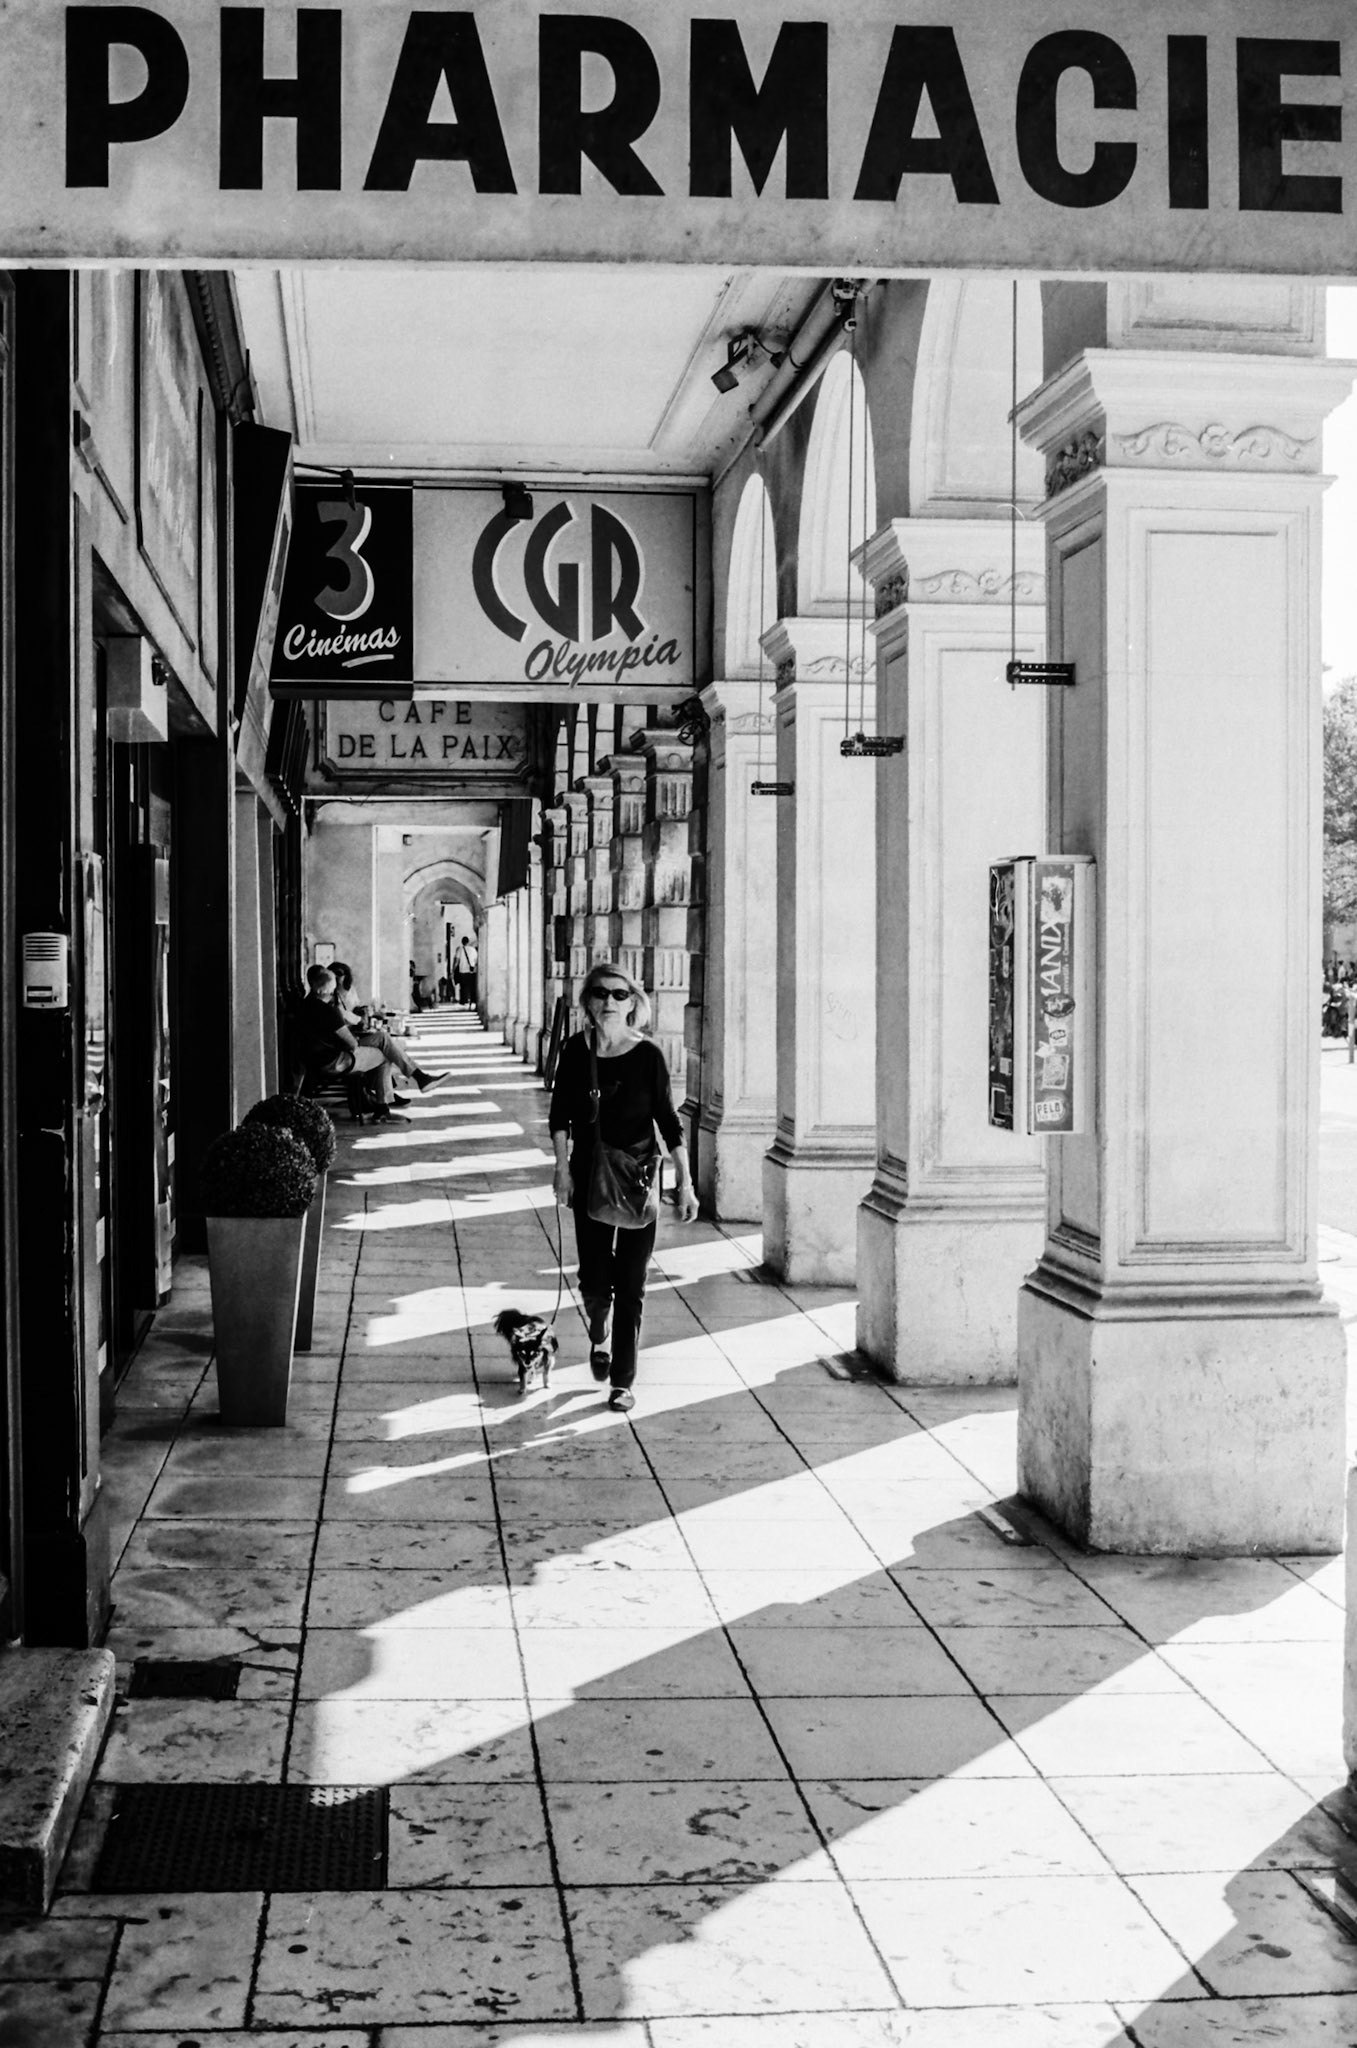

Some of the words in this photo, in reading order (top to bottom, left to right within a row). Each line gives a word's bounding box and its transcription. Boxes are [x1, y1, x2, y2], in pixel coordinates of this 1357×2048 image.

[64, 4, 1344, 215] PHARMACIE
[314, 501, 375, 621] 3
[472, 500, 648, 643] CGR
[283, 623, 401, 661] Cinémas
[525, 634, 682, 688] Olympia
[378, 700, 473, 725] CAFE
[338, 734, 376, 759] DE
[391, 734, 428, 759] LA
[442, 735, 516, 760] PAIX
